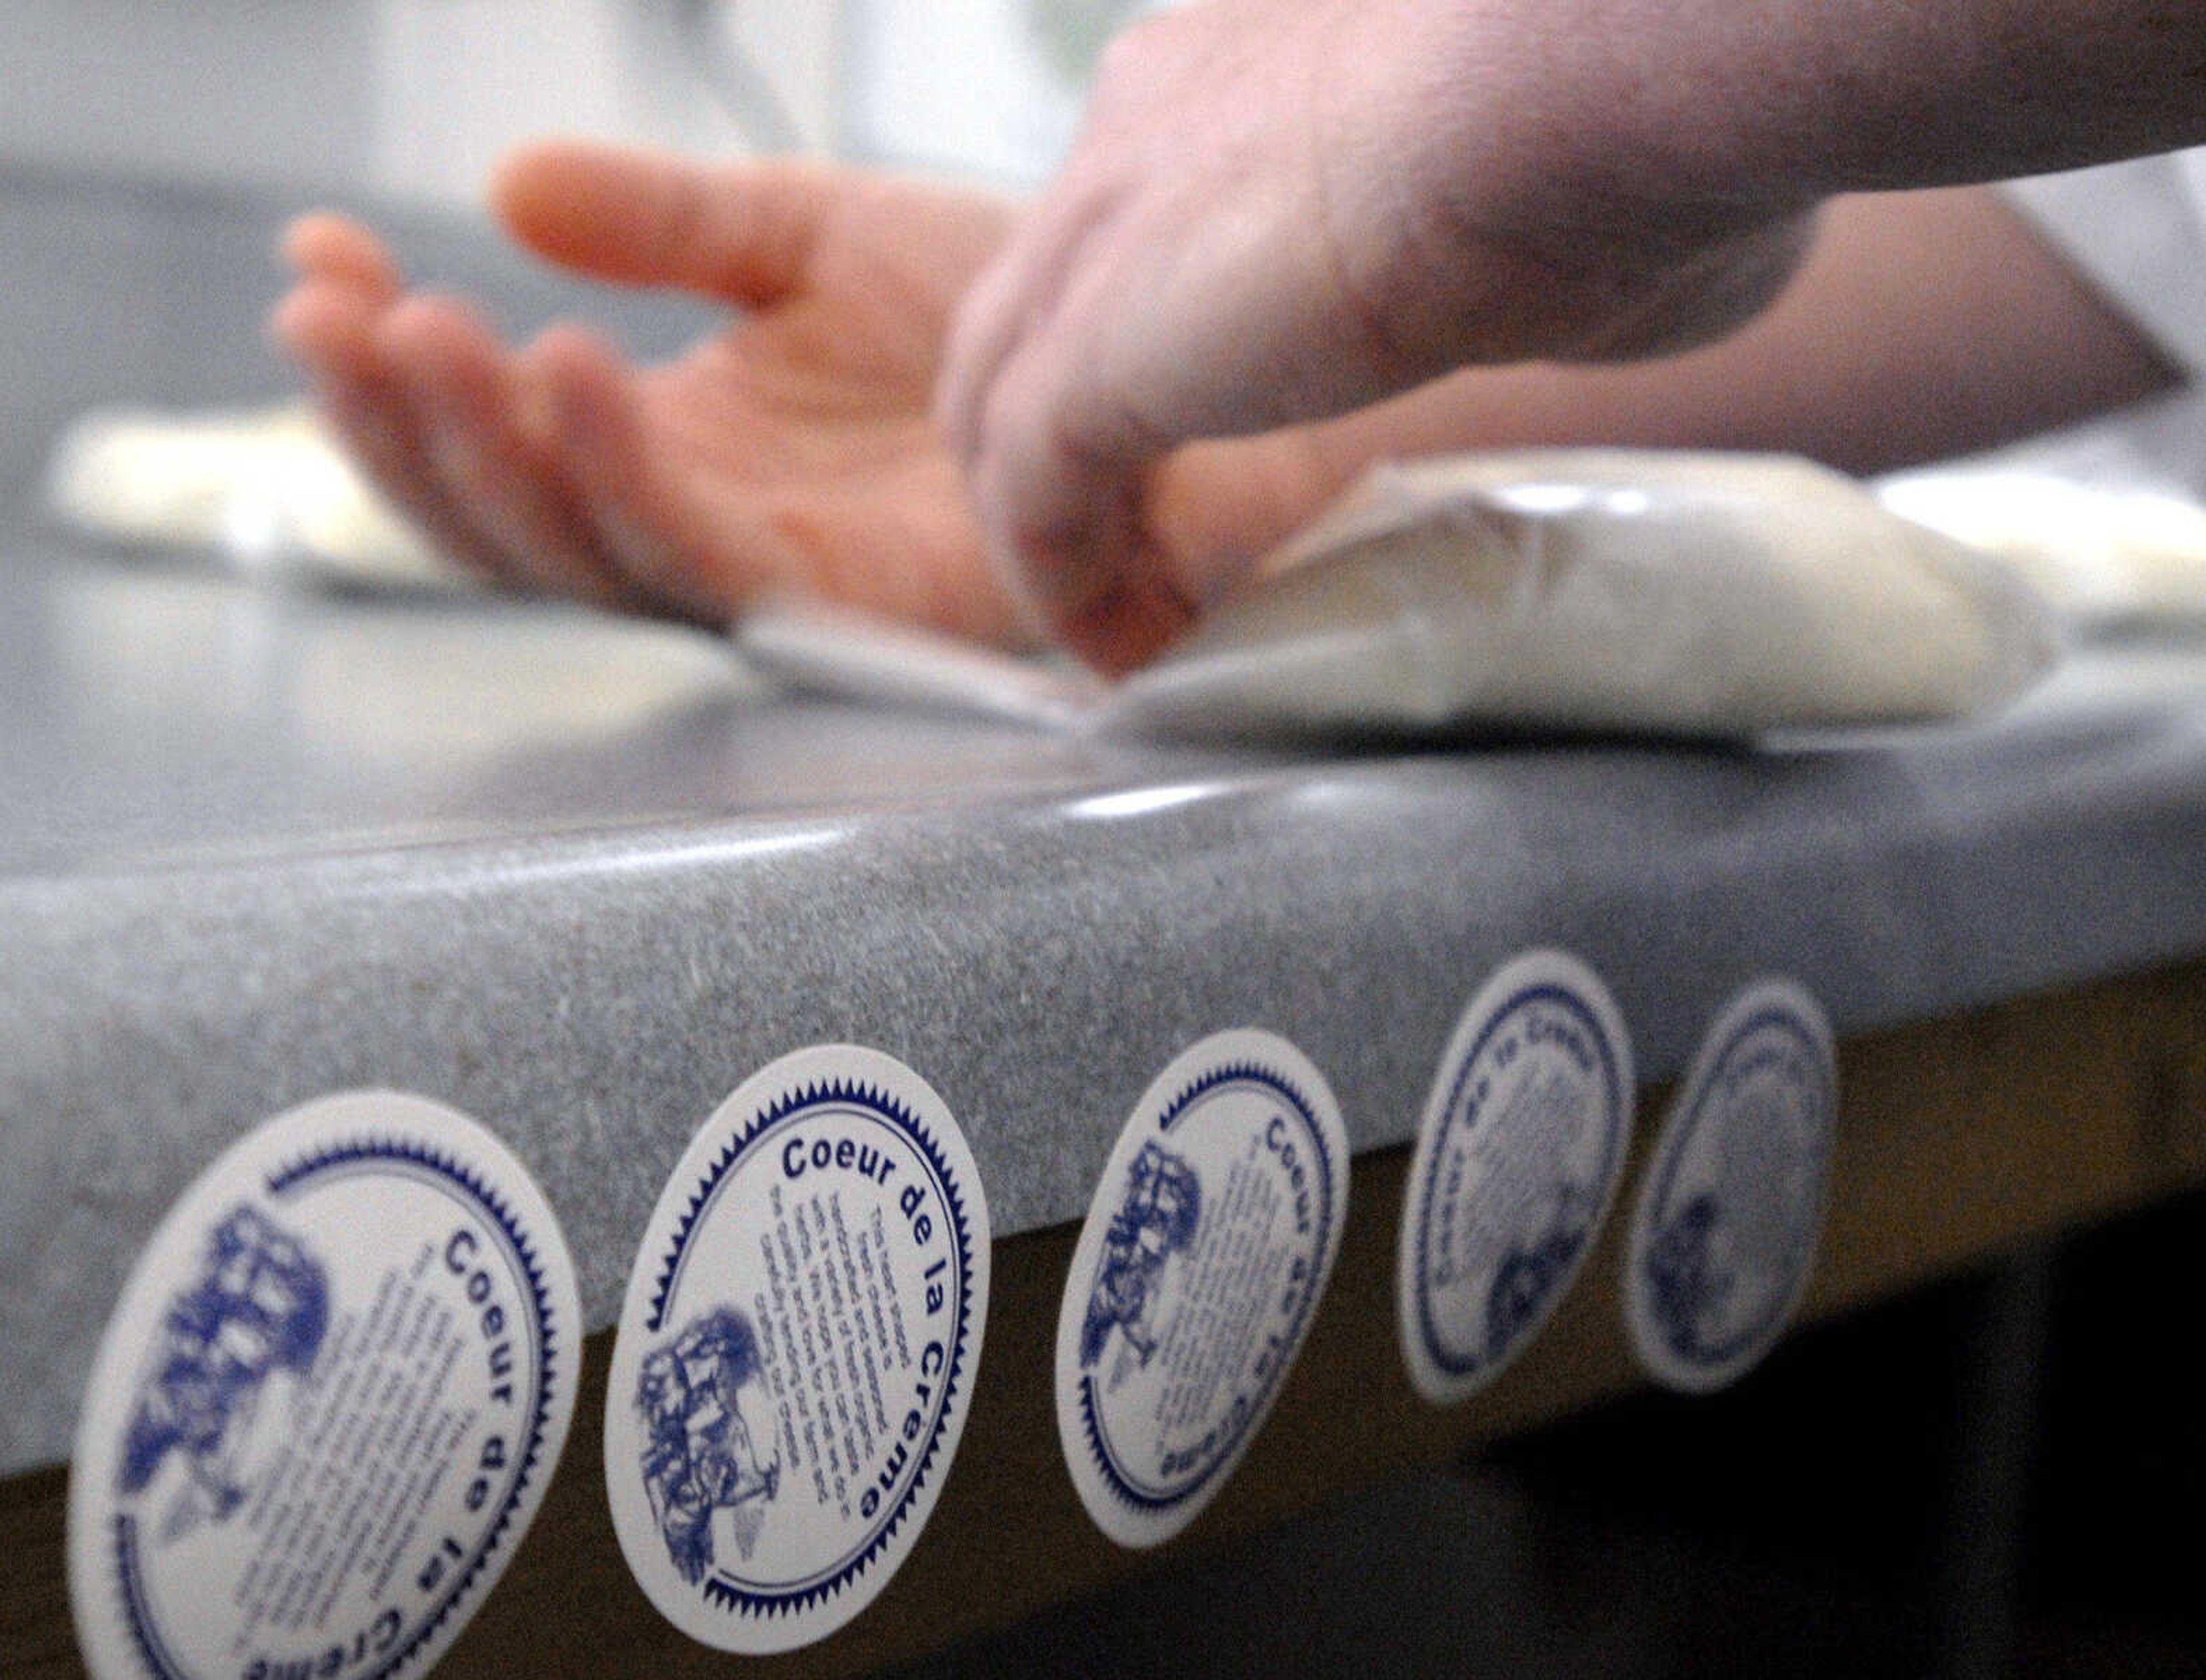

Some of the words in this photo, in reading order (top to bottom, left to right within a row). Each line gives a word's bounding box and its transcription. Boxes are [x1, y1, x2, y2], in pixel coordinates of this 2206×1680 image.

[782, 1138, 896, 1186] Coeur
[900, 1184, 932, 1246] de
[924, 1259, 947, 1315] la
[446, 1230, 512, 1407] Coeur
[465, 1436, 505, 1512] de
[418, 1535, 463, 1592] la
